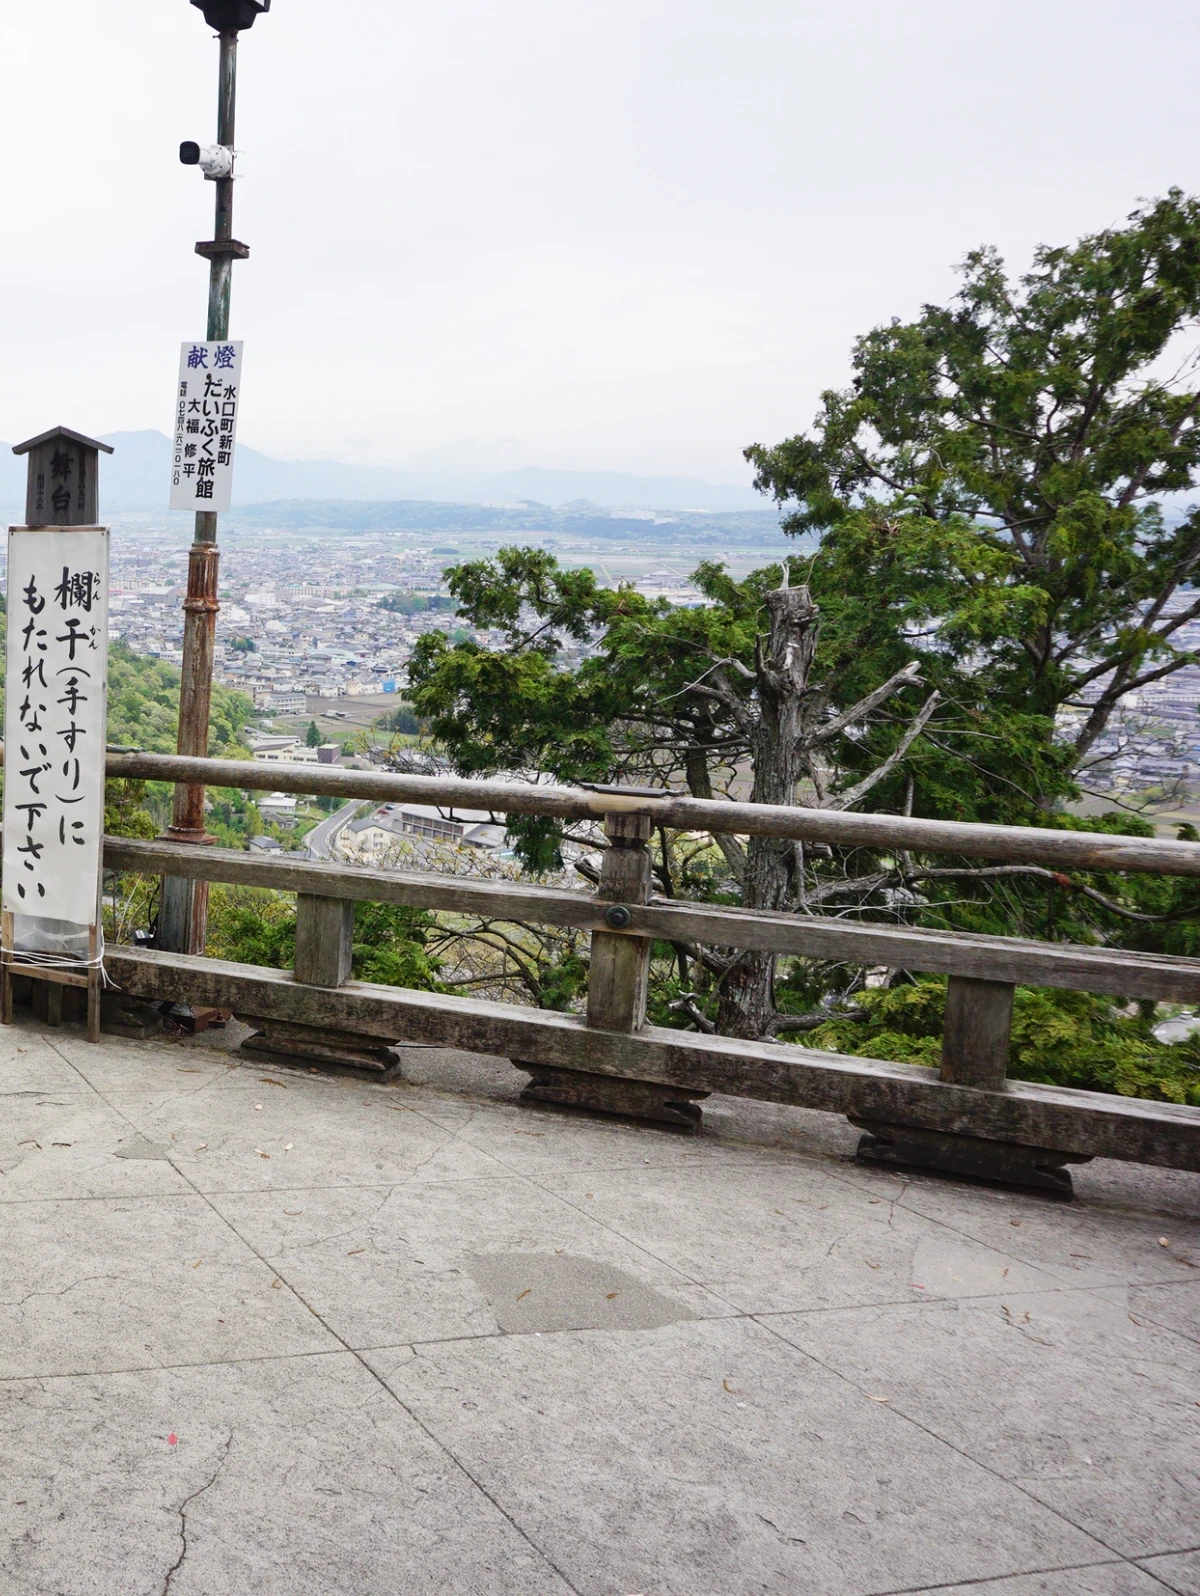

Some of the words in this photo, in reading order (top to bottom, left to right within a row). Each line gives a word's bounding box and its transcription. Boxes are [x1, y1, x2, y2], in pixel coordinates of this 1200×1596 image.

[187, 345, 236, 369] 献燈
[195, 378, 222, 499] だいふく旅館
[217, 385, 236, 466] 水口町新町
[50, 448, 74, 512] 舞台
[15, 573, 52, 899] もたれないで下さい
